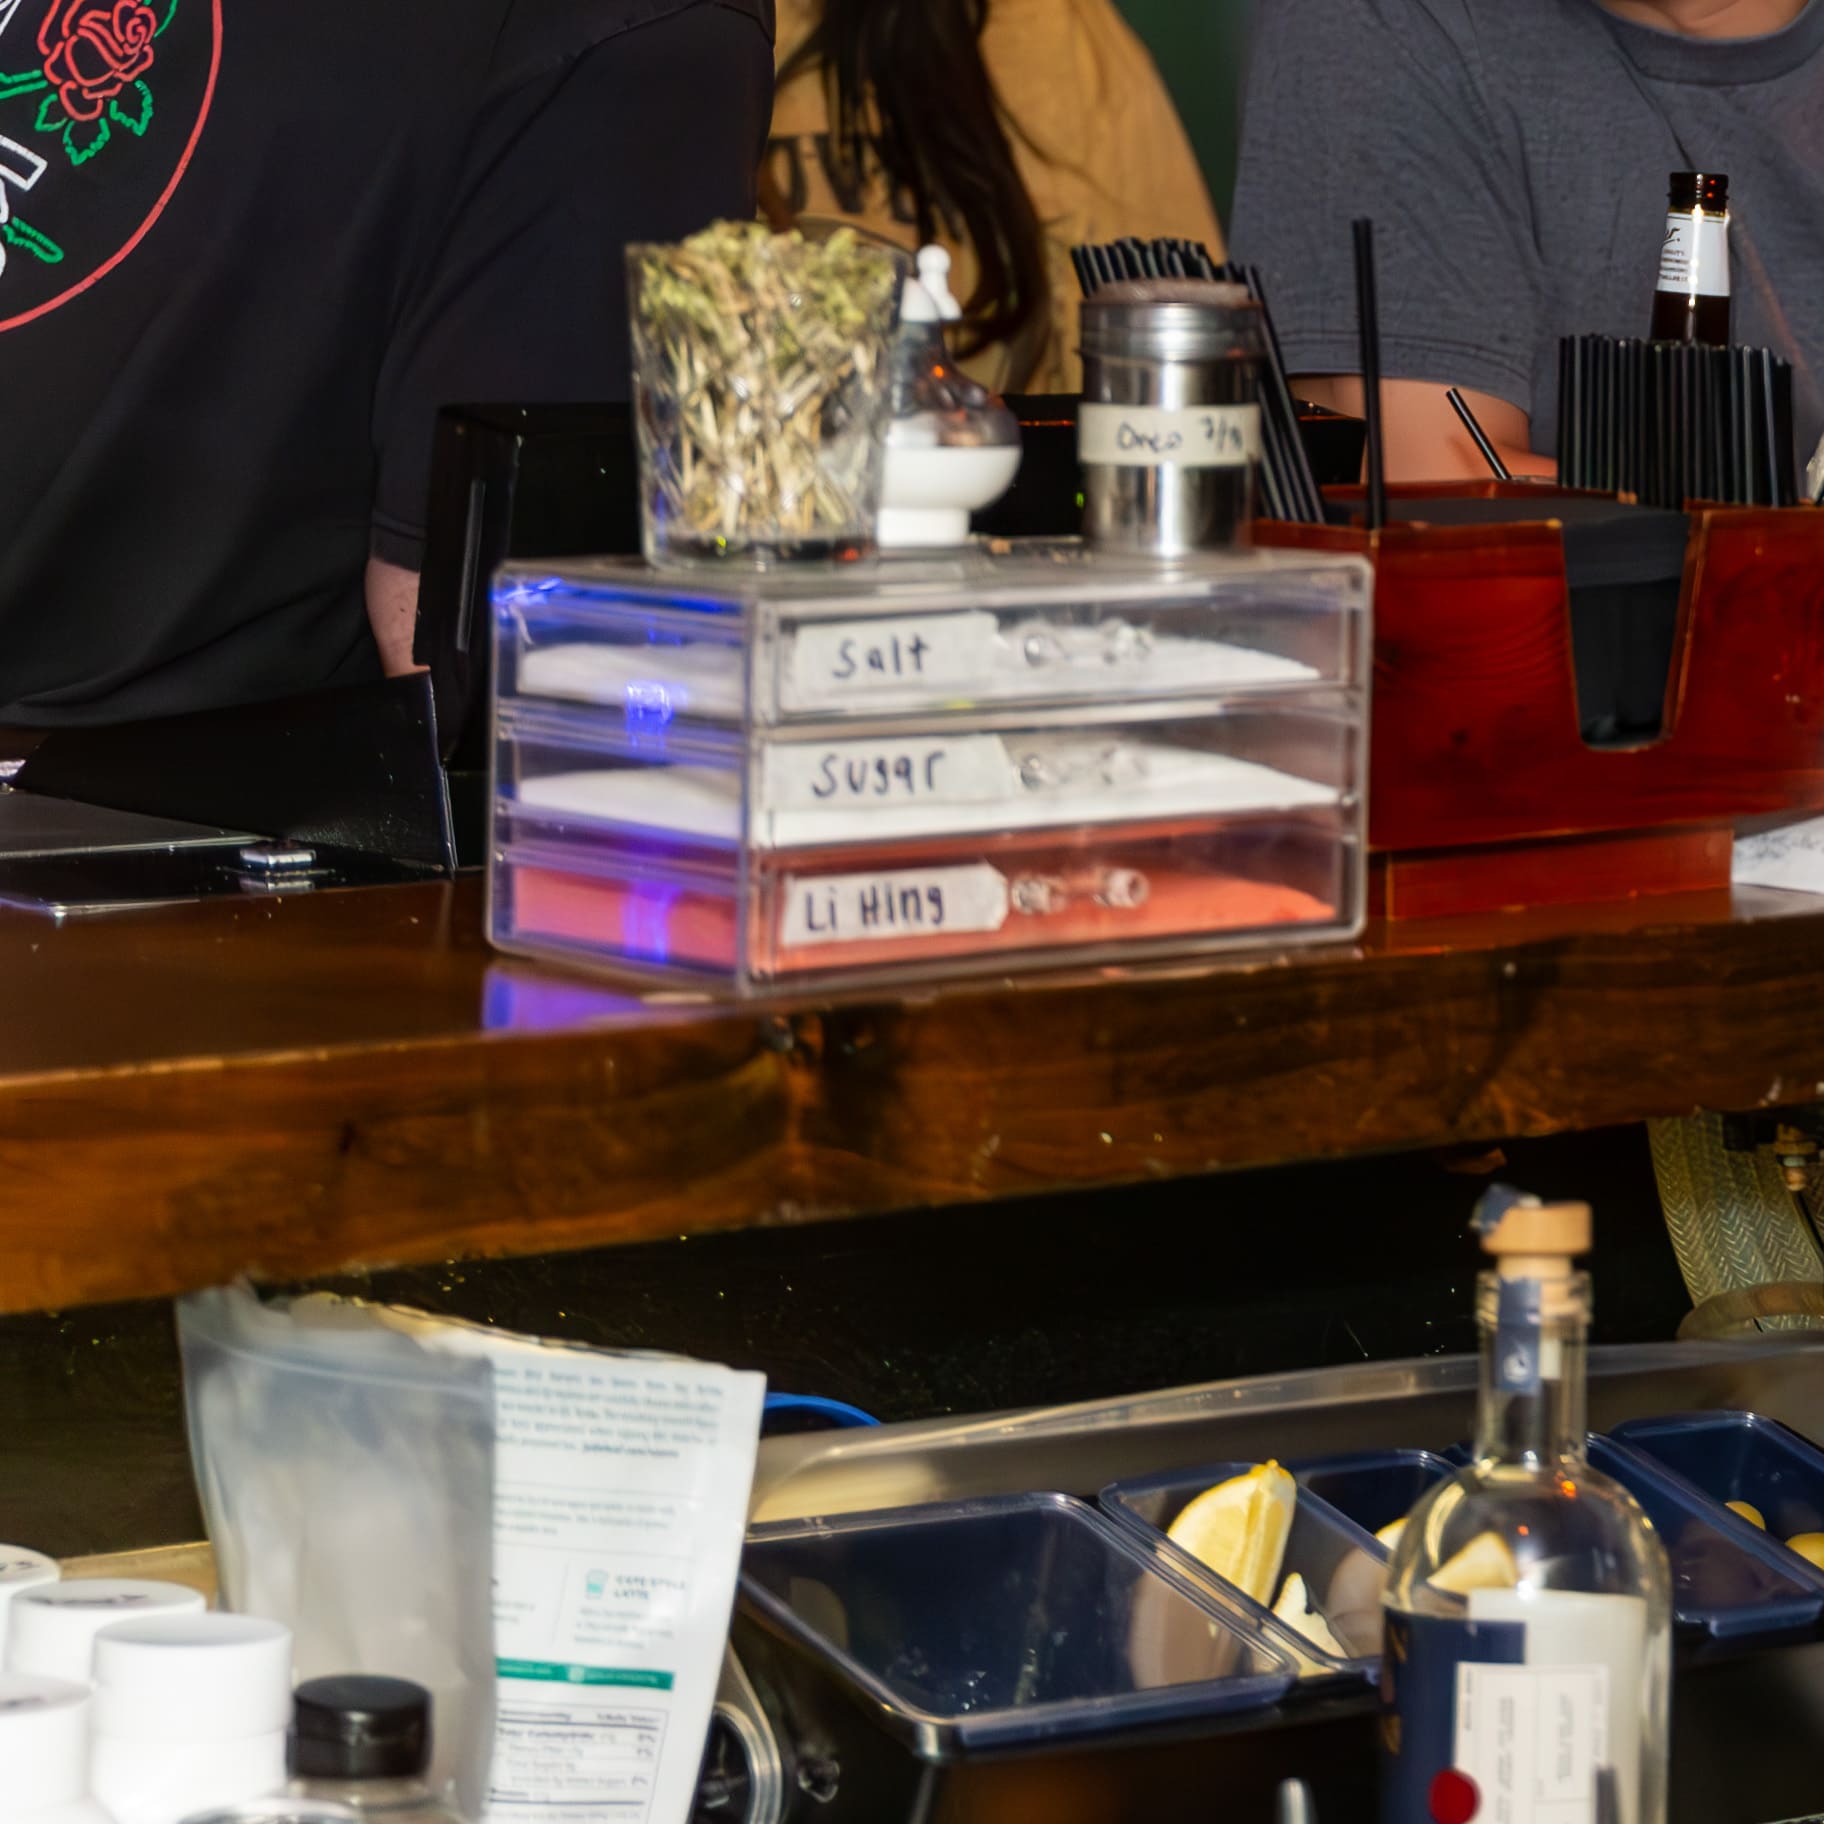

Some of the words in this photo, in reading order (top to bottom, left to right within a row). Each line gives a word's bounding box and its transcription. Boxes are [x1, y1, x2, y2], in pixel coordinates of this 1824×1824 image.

[832, 634, 931, 679] Salt
[811, 750, 947, 798] Sugar
[806, 886, 837, 932] Li
